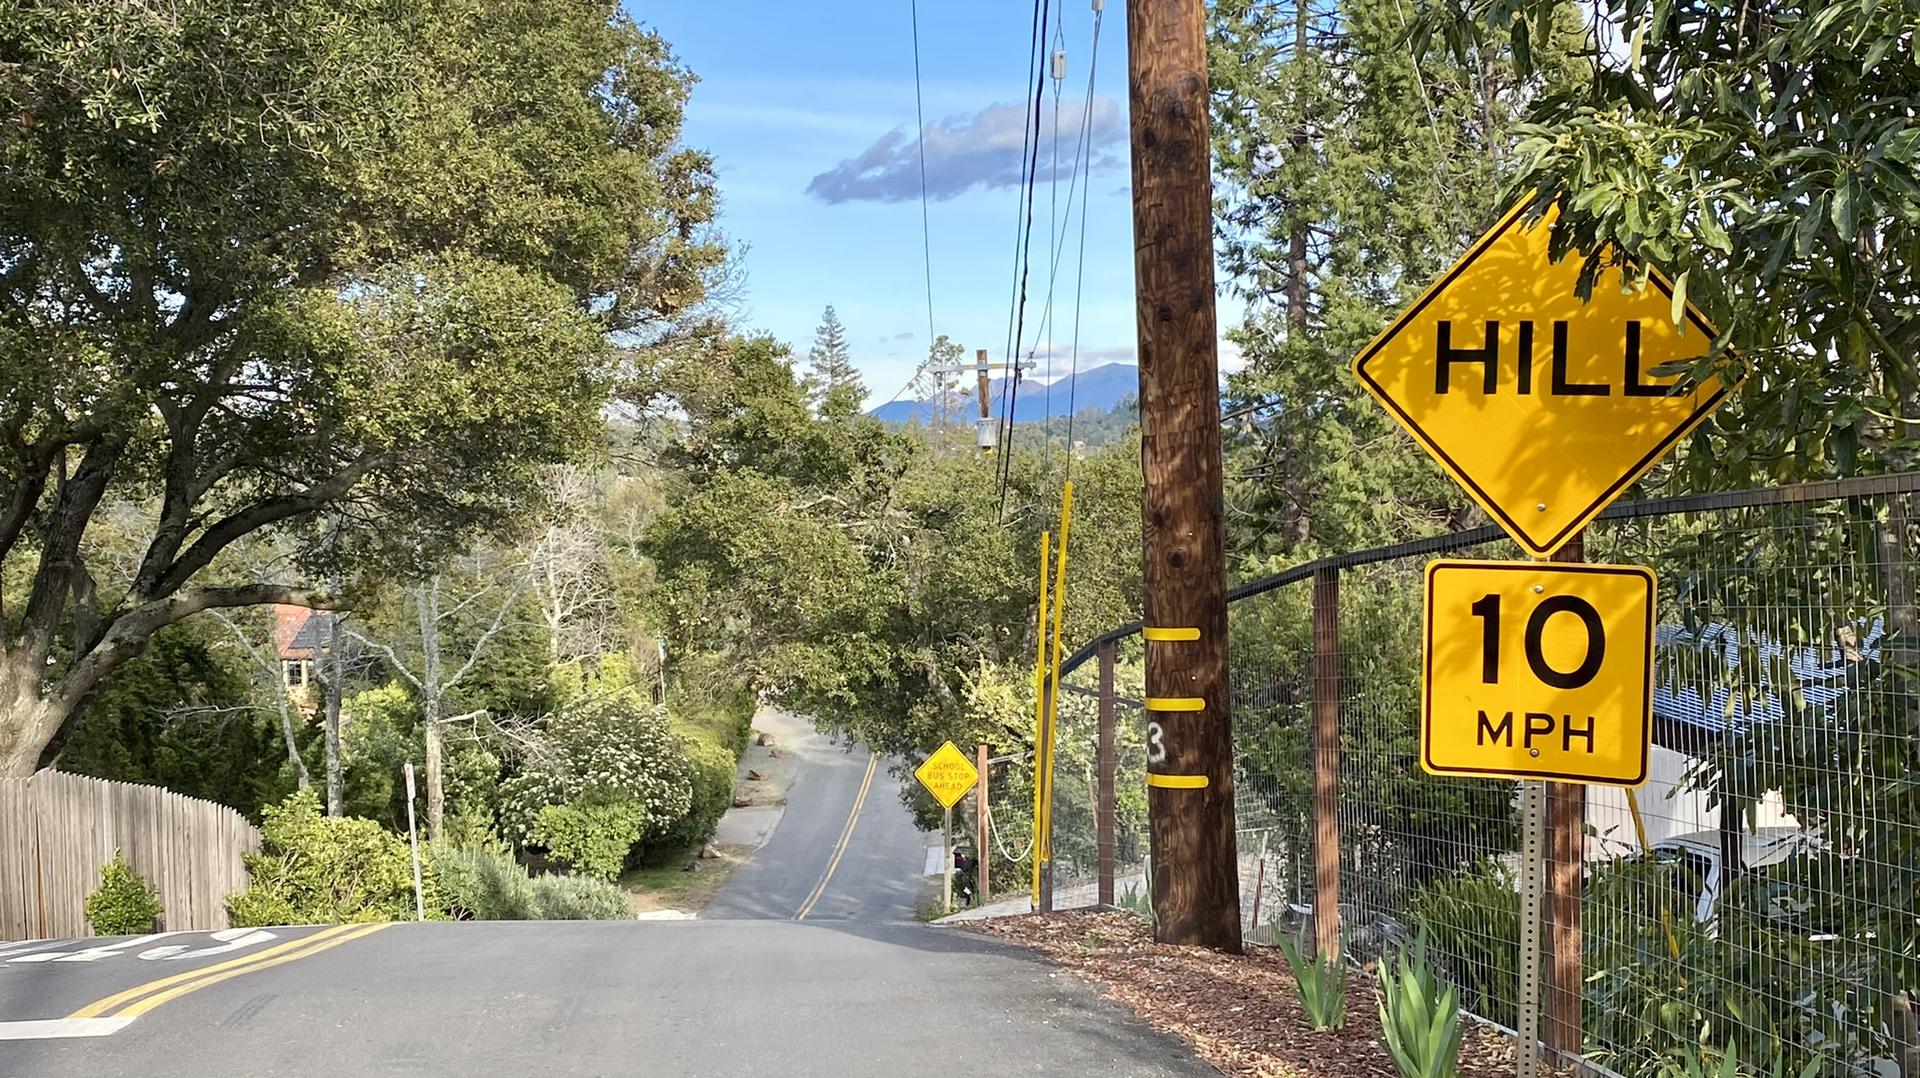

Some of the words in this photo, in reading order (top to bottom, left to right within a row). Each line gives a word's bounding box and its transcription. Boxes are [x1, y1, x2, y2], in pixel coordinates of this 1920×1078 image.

[1434, 319, 1686, 397] HILL
[1471, 593, 1606, 690] 10
[1476, 710, 1595, 754] MPH
[927, 771, 945, 780] BUS
[947, 772, 970, 781] STOP
[932, 761, 966, 771] SCHOOL
[933, 782, 963, 791] AHEAD
